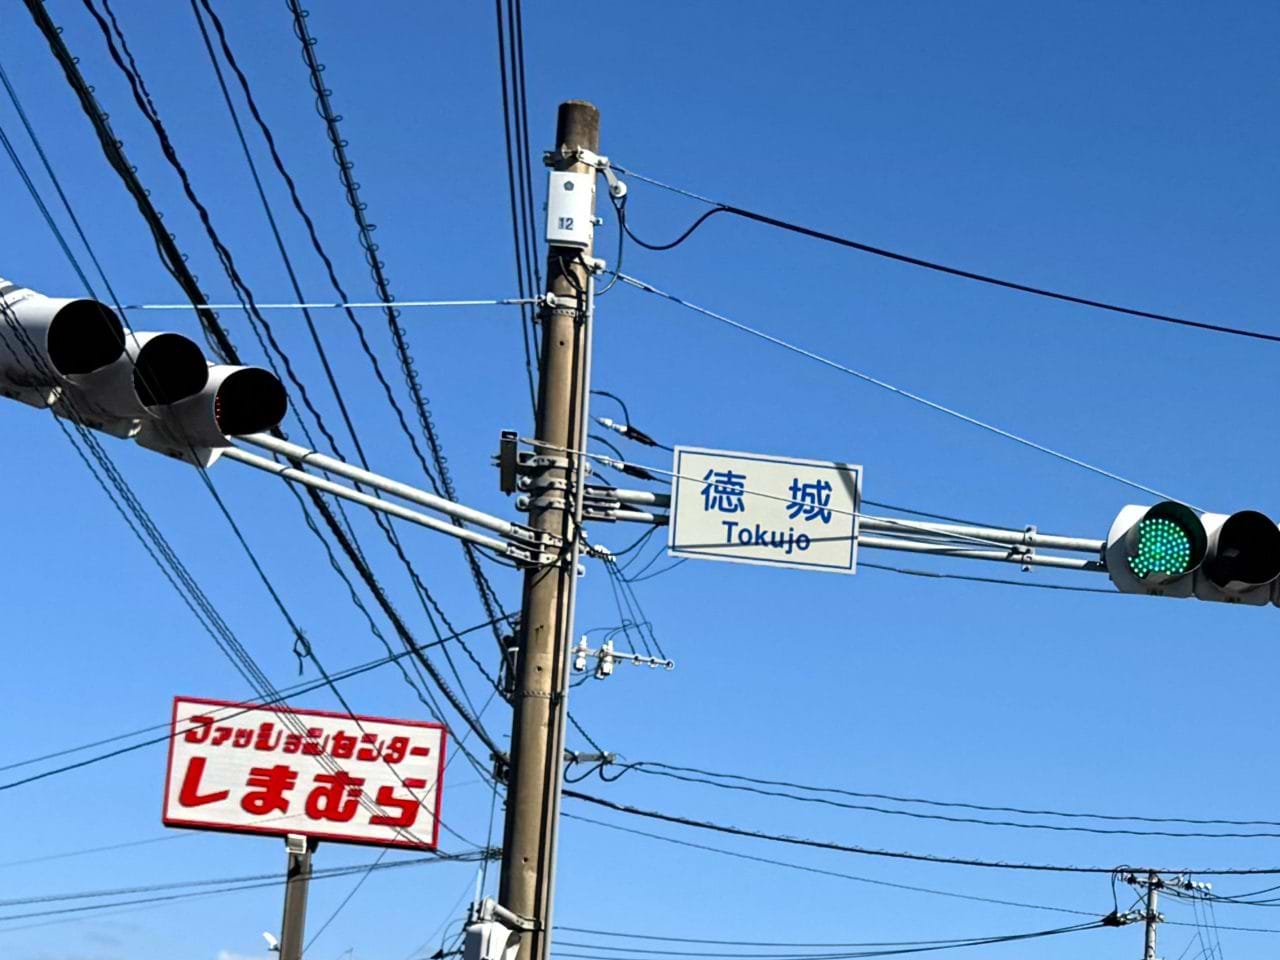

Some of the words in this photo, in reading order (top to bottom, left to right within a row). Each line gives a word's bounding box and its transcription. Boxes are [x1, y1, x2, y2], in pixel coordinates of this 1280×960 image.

[701, 469, 833, 524] 徳城
[722, 520, 811, 554] Tokujo
[184, 715, 431, 764] ファッションセンター
[178, 756, 428, 828] しまむら
